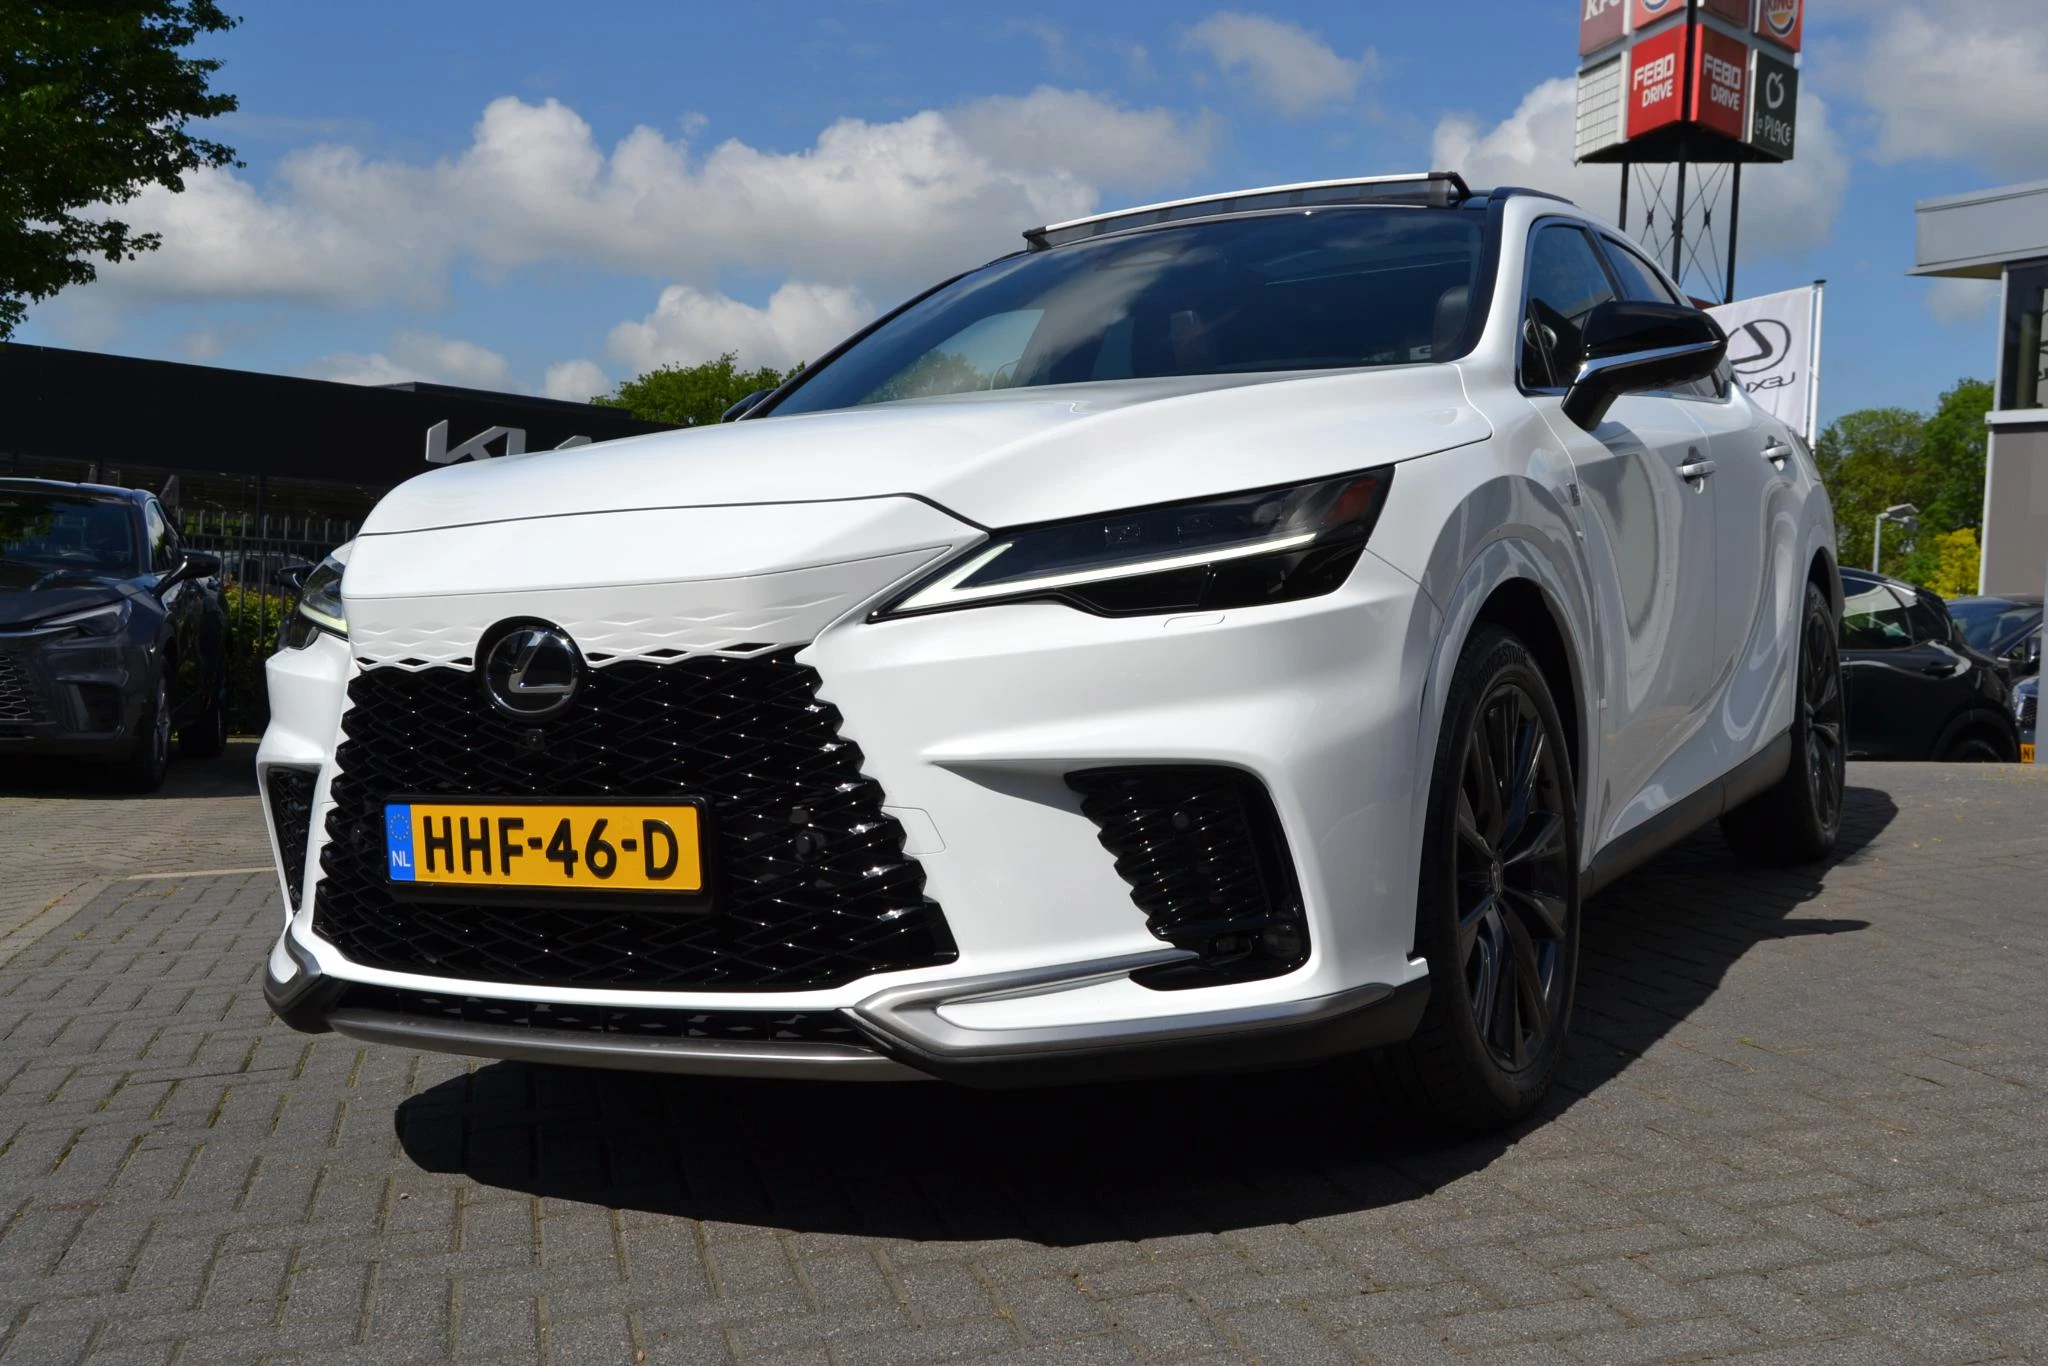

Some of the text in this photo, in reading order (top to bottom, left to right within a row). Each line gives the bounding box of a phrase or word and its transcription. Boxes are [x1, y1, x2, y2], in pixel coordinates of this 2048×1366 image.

[1633, 53, 1675, 91] FEBO
[1703, 53, 1741, 90] FEBO
[1641, 78, 1673, 108] DRIVE
[1711, 83, 1740, 111] DRIVE
[1764, 115, 1792, 146] PLACE
[391, 850, 411, 868] NL
[422, 815, 679, 881] HHF-46-D
